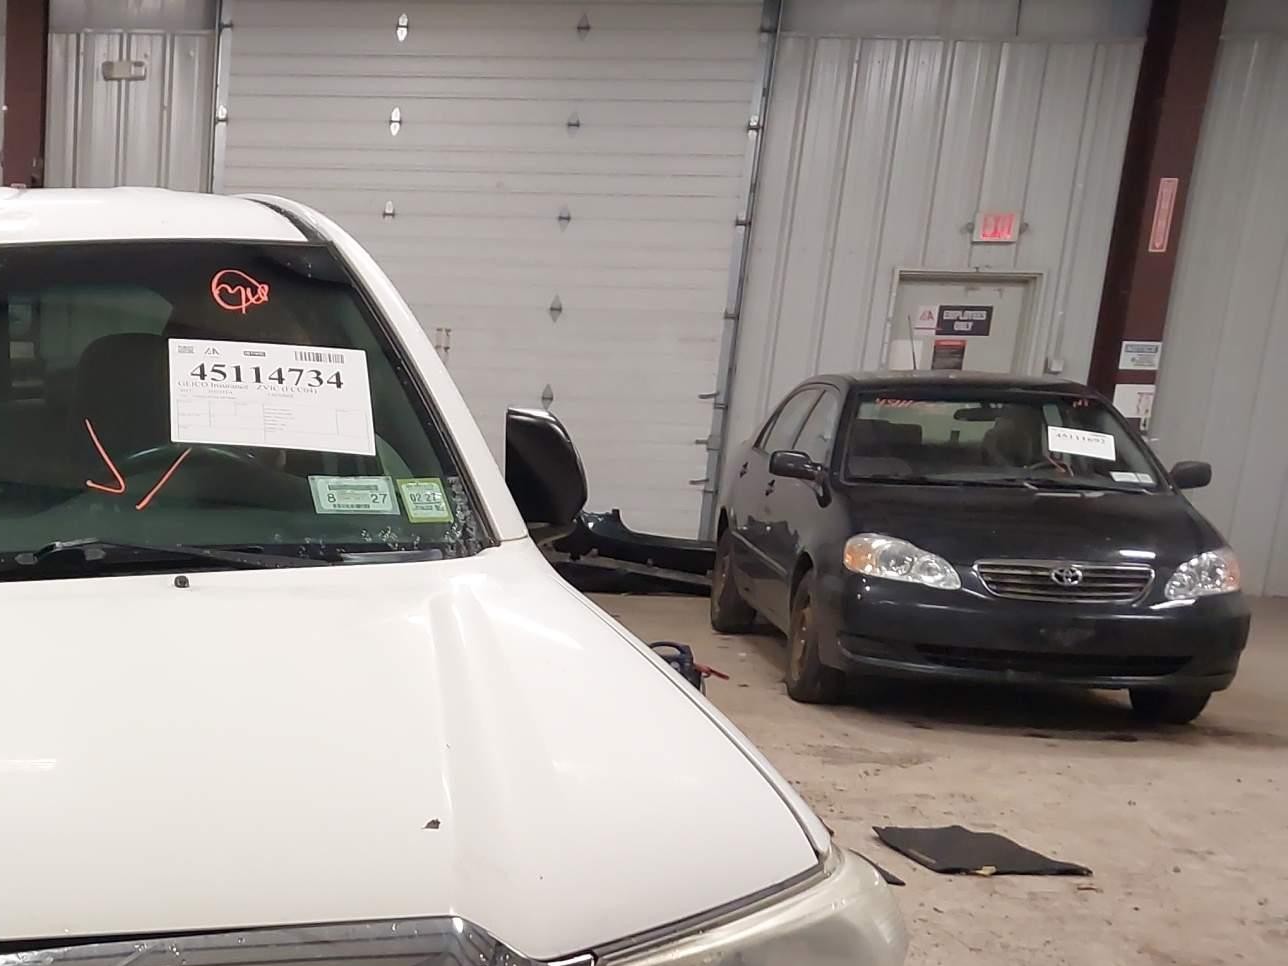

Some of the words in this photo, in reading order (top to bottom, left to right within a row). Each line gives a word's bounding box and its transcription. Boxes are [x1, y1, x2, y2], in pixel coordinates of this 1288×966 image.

[190, 362, 344, 389] 45114734
[326, 493, 337, 503] 8
[370, 493, 387, 504] 27
